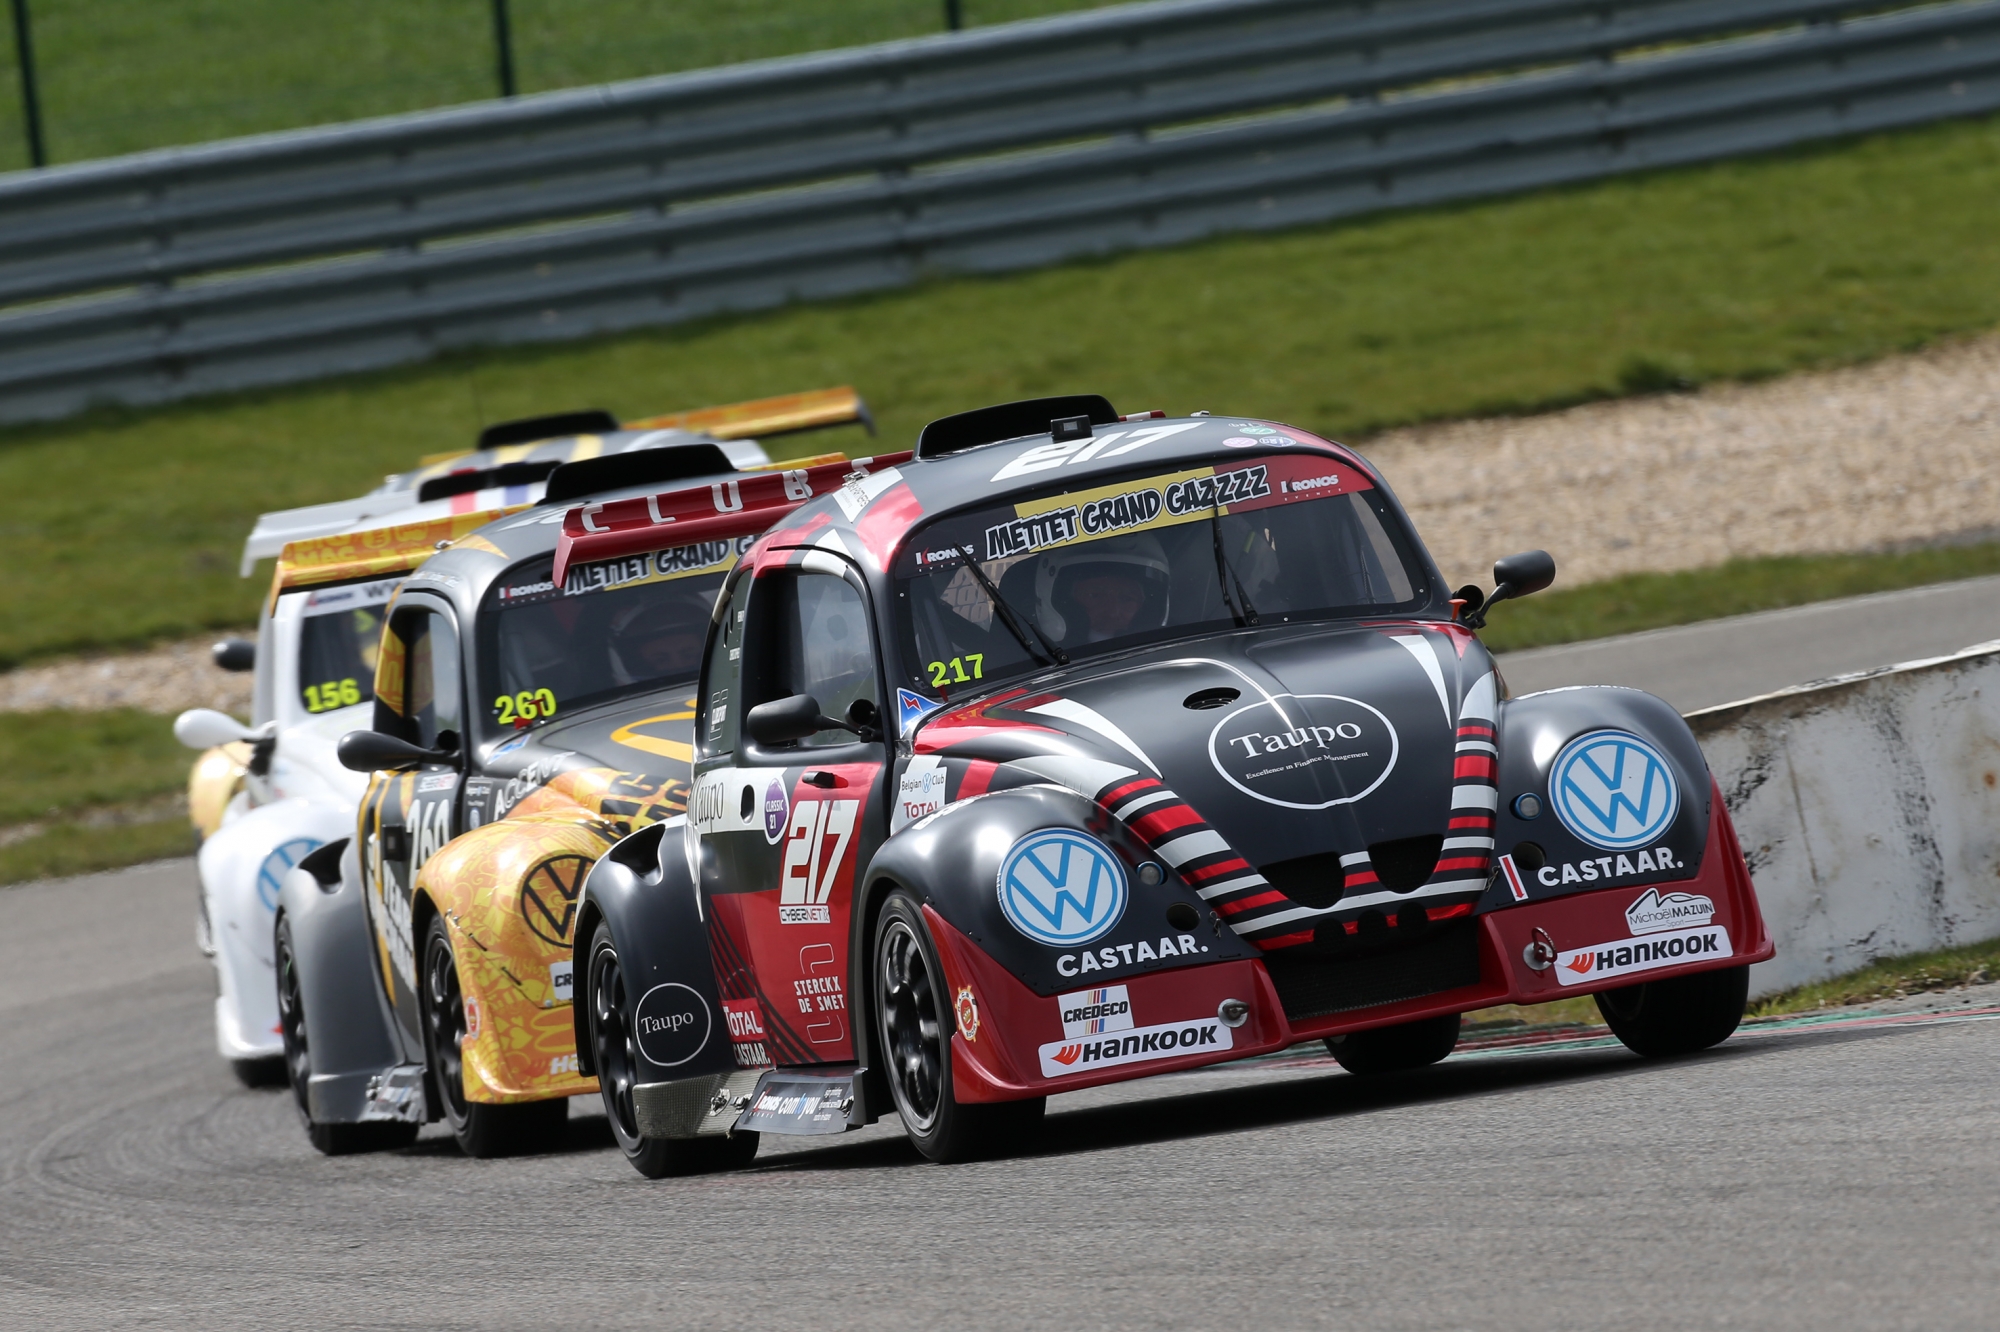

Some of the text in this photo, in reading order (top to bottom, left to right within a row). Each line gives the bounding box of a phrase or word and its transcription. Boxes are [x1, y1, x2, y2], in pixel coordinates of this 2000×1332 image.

[990, 422, 1206, 482] 217
[1280, 474, 1339, 494] KRONOS
[985, 505, 1079, 560] METTET
[1080, 488, 1163, 535] GRAND
[563, 556, 654, 597] METTET
[654, 537, 732, 578] GRAND
[499, 581, 554, 600] KRONOS
[928, 652, 985, 688] 217
[303, 677, 361, 714] 156
[494, 687, 557, 725] 260
[1229, 722, 1362, 759] Taupo
[1245, 765, 1285, 780] Excellence
[1294, 756, 1323, 768] Finance
[1323, 751, 1370, 762] Management
[902, 778, 922, 793] Belgian
[932, 774, 945, 786] Club
[765, 799, 784, 813] CLASSIC
[769, 814, 777, 830] 21
[780, 800, 860, 905] 217
[1537, 846, 1684, 887] CASTAAR.
[1056, 934, 1209, 978] CASTAAR.
[793, 976, 842, 996] STERCKX
[798, 994, 845, 1014] DE SMET
[1063, 1001, 1129, 1023] CREDECO
[641, 1012, 694, 1035] Taupo
[722, 1005, 764, 1037] TOTAL
